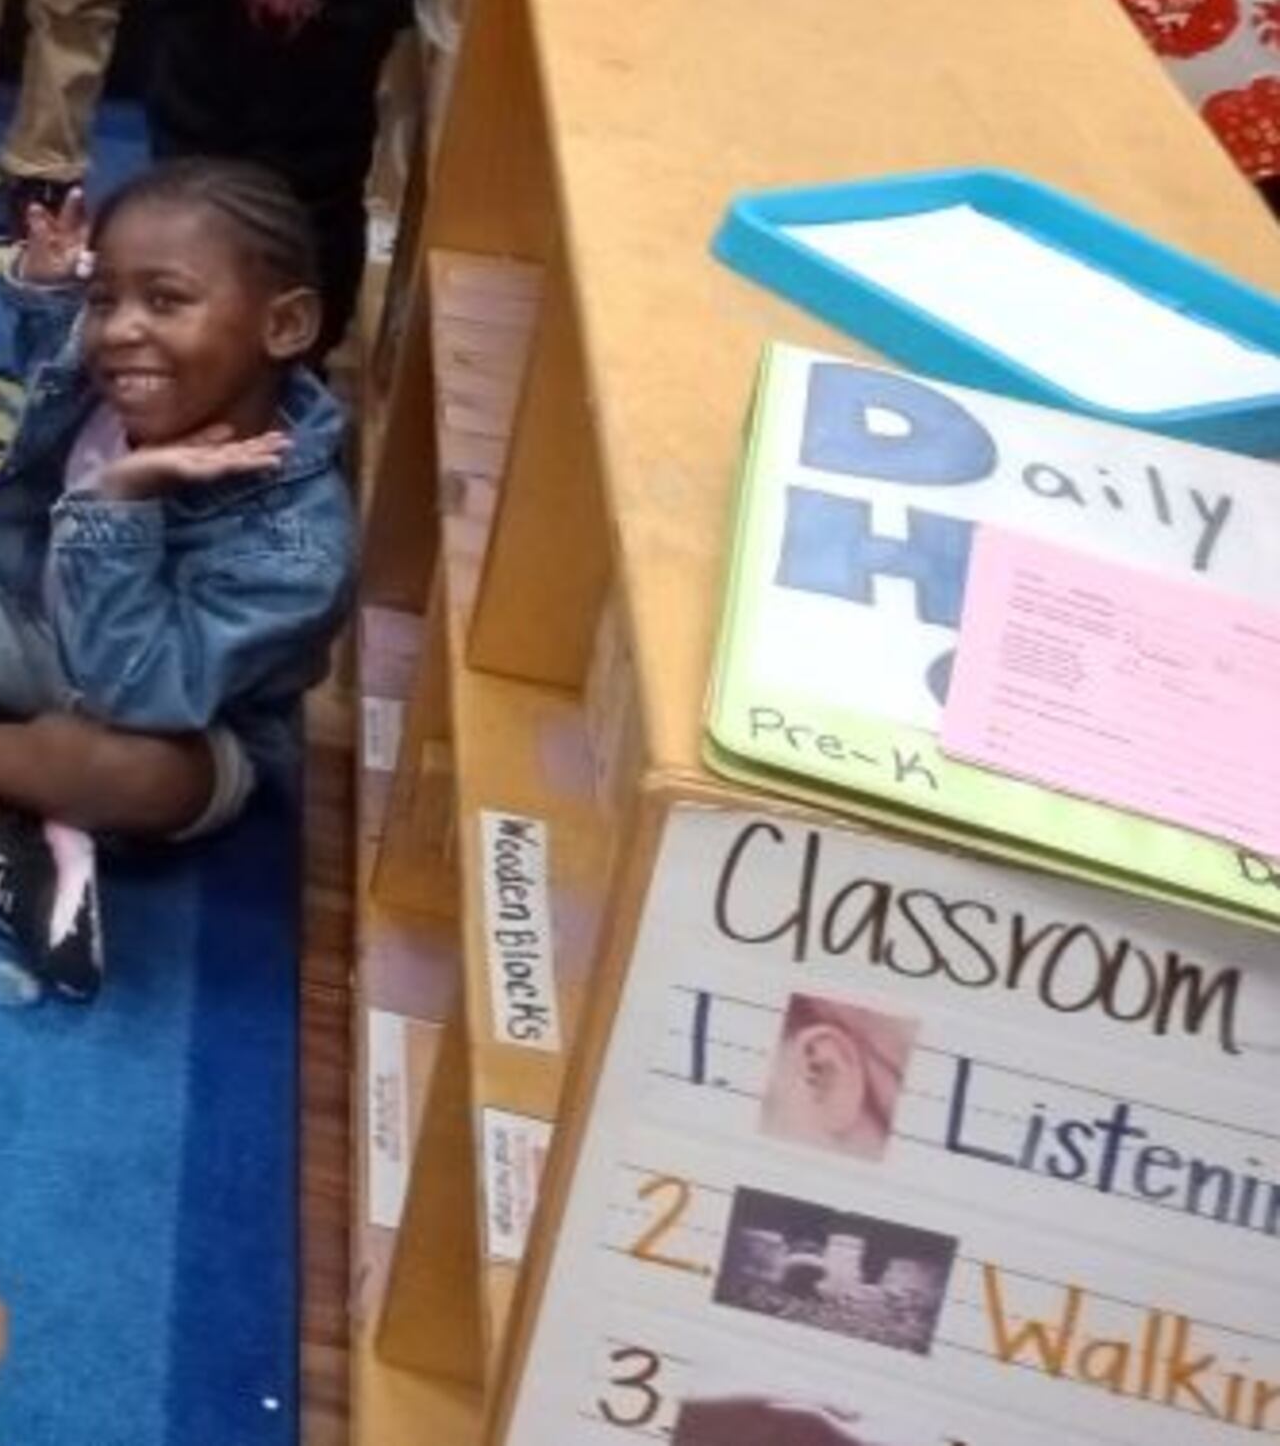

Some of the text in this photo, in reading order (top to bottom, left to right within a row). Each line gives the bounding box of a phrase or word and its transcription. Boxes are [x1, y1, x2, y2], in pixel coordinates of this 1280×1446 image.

[798, 361, 1234, 572] Daily
[494, 816, 540, 922] Wooden
[713, 821, 1246, 1054] Classroom
